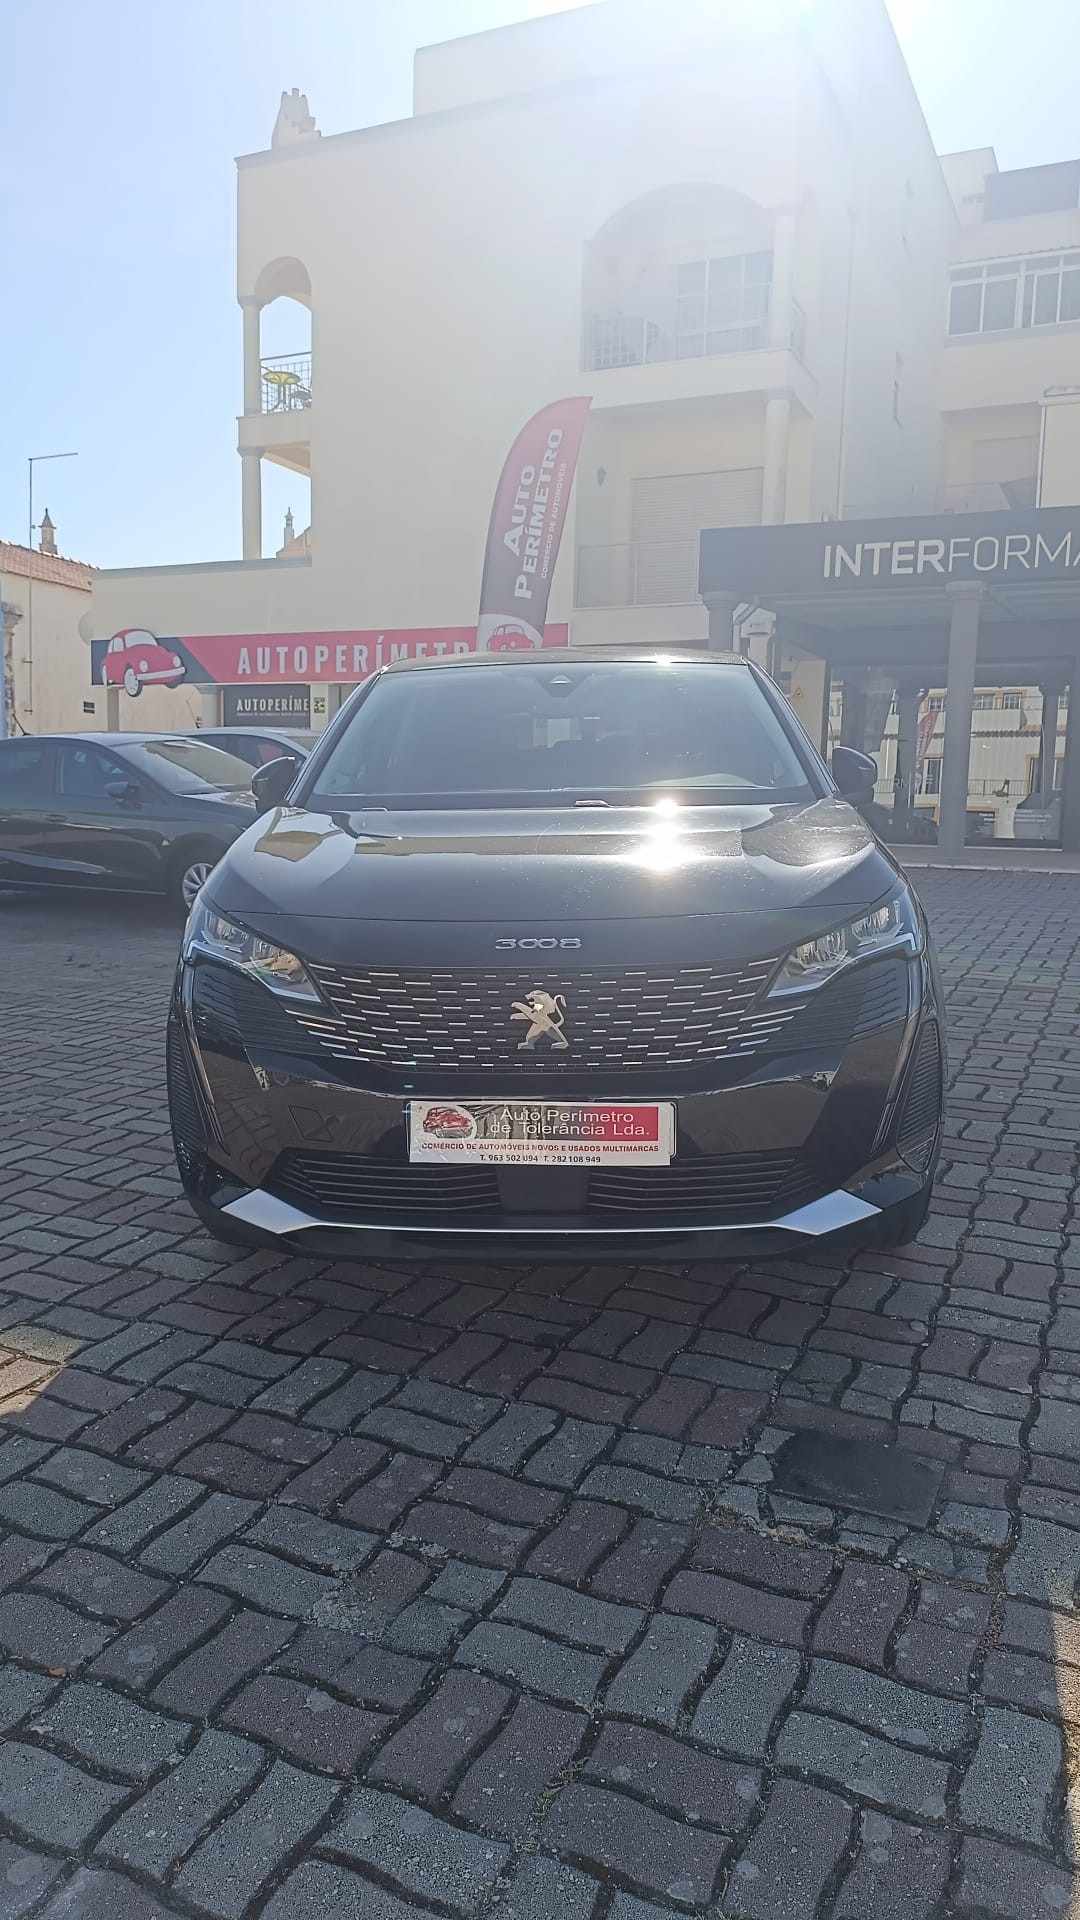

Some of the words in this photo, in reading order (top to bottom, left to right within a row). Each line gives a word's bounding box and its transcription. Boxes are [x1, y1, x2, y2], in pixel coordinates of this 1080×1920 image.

[503, 465, 535, 556] AUTO
[514, 429, 562, 599] PERÍMETRO
[823, 531, 1080, 578] INTERFORM
[236, 695, 309, 713] AUTOPERÍME
[495, 937, 582, 950] 3008
[500, 1107, 541, 1121] Auto
[547, 1109, 634, 1122] Perímetro
[490, 1120, 512, 1134] de
[519, 1121, 605, 1135] Tolerância
[613, 1124, 650, 1136] Lda.
[466, 1143, 477, 1151] DE
[531, 1144, 560, 1152] NOVOS
[561, 1144, 567, 1152] E
[568, 1144, 601, 1152] USADOS
[602, 1145, 659, 1153] MULTIMARCAS
